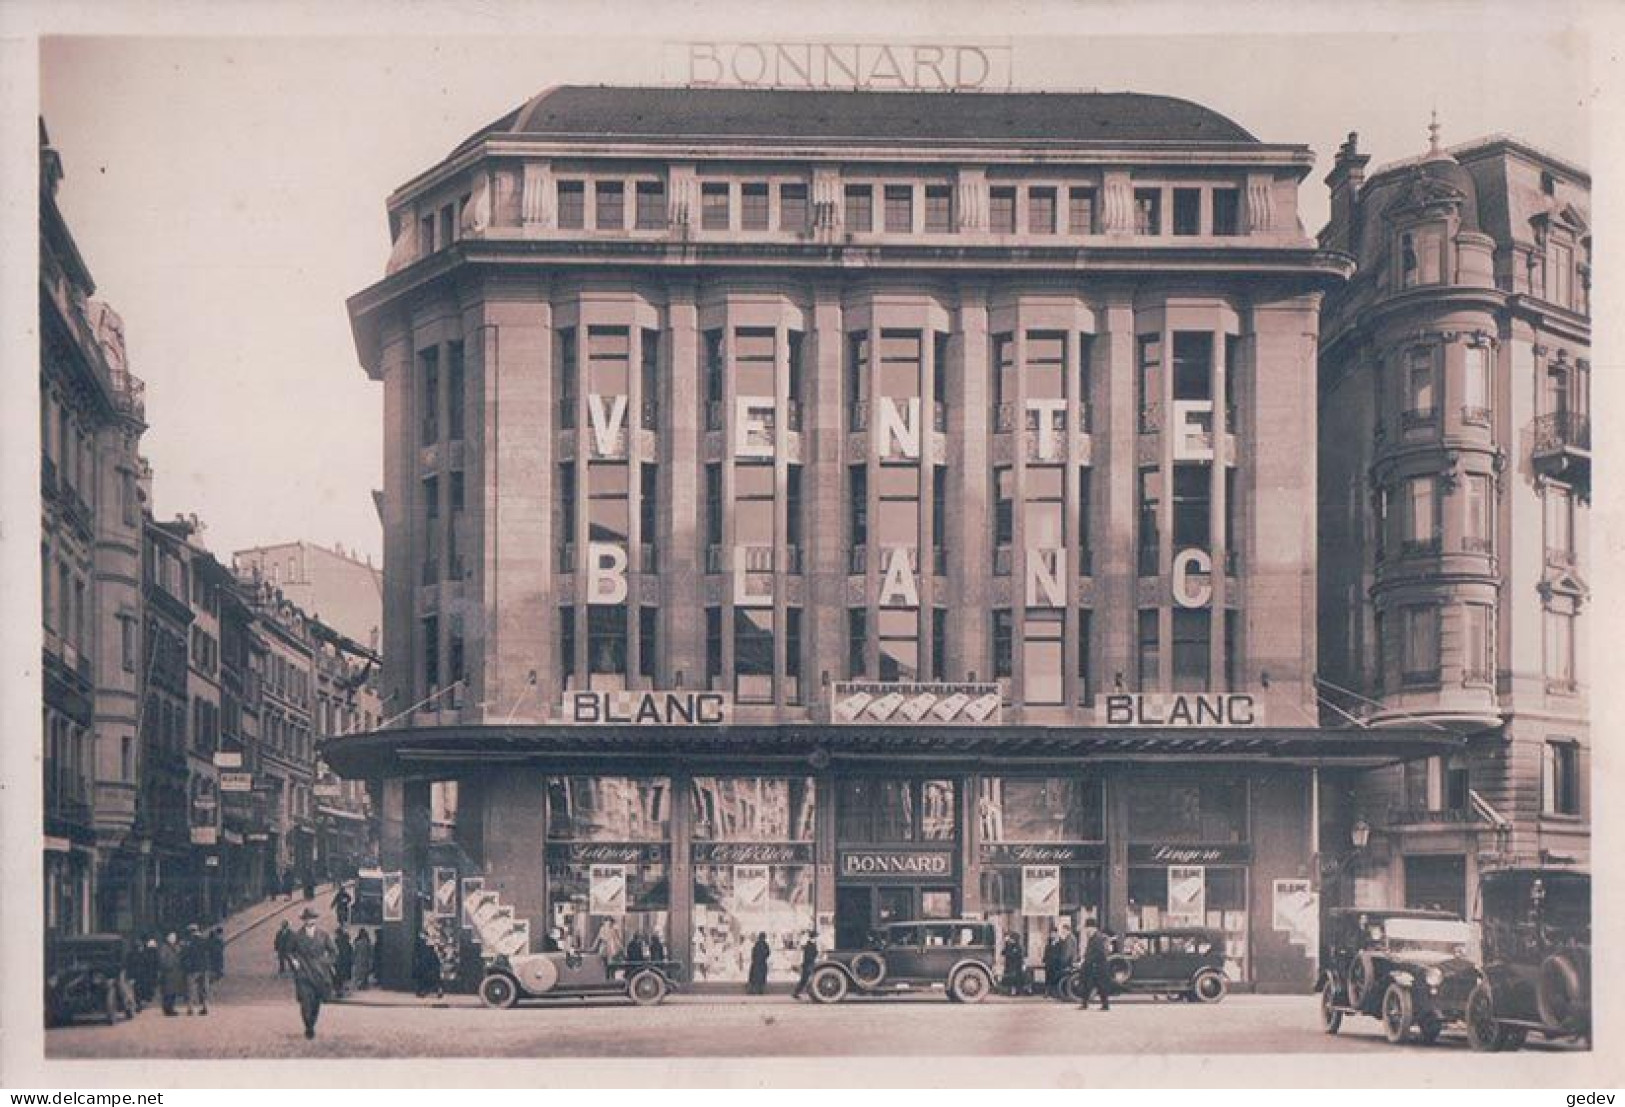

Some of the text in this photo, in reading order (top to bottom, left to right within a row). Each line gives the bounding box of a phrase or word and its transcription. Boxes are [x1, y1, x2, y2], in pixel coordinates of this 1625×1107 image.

[690, 42, 990, 89] BONNARD
[588, 394, 1213, 461] VENTE
[588, 541, 1212, 608] BLANC
[574, 693, 724, 722] BLANC
[1107, 695, 1254, 724] BLANC
[847, 855, 946, 874] BONNARD
